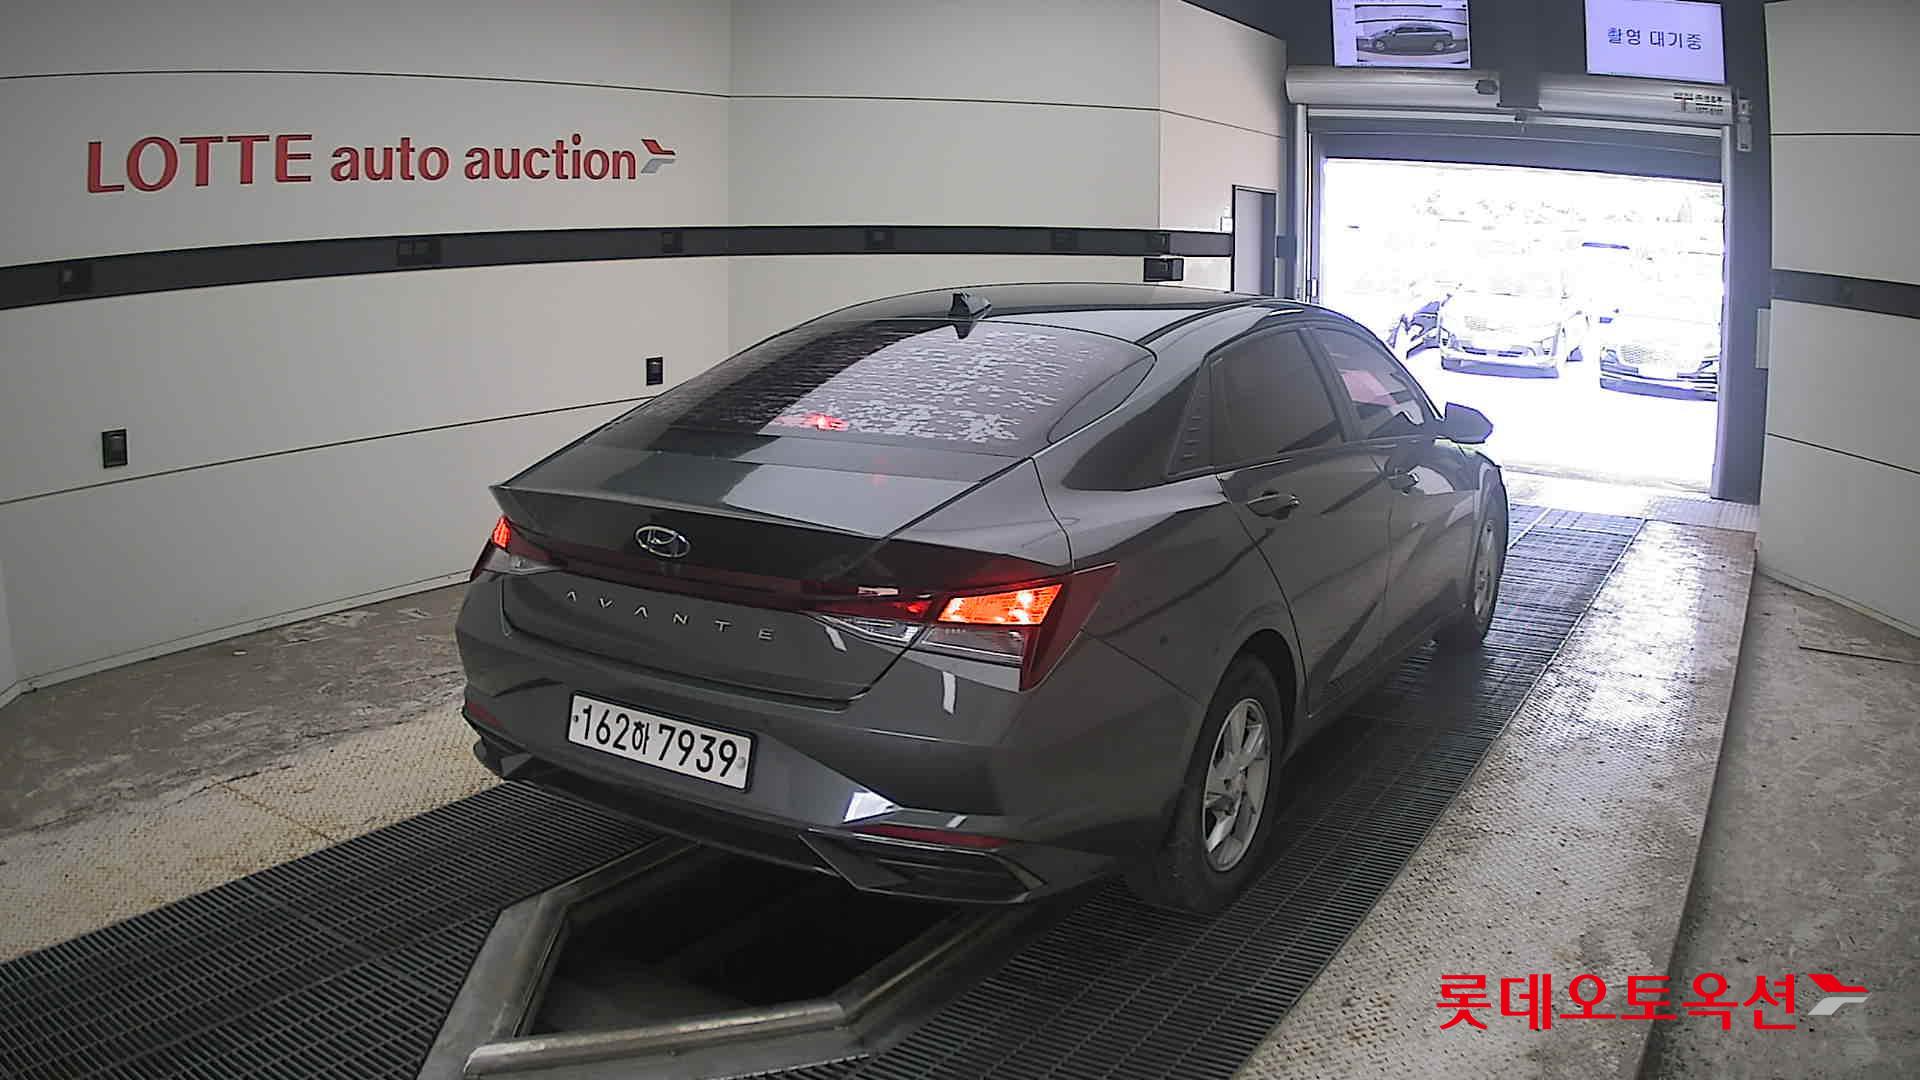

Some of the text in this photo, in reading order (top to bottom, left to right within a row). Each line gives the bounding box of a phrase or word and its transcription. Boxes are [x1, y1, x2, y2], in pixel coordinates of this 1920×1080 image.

[1650, 30, 1702, 50] 대기중
[86, 133, 638, 194] LOTTE auto auction
[566, 591, 775, 641] AVANTE
[582, 704, 738, 778] 162하 7939
